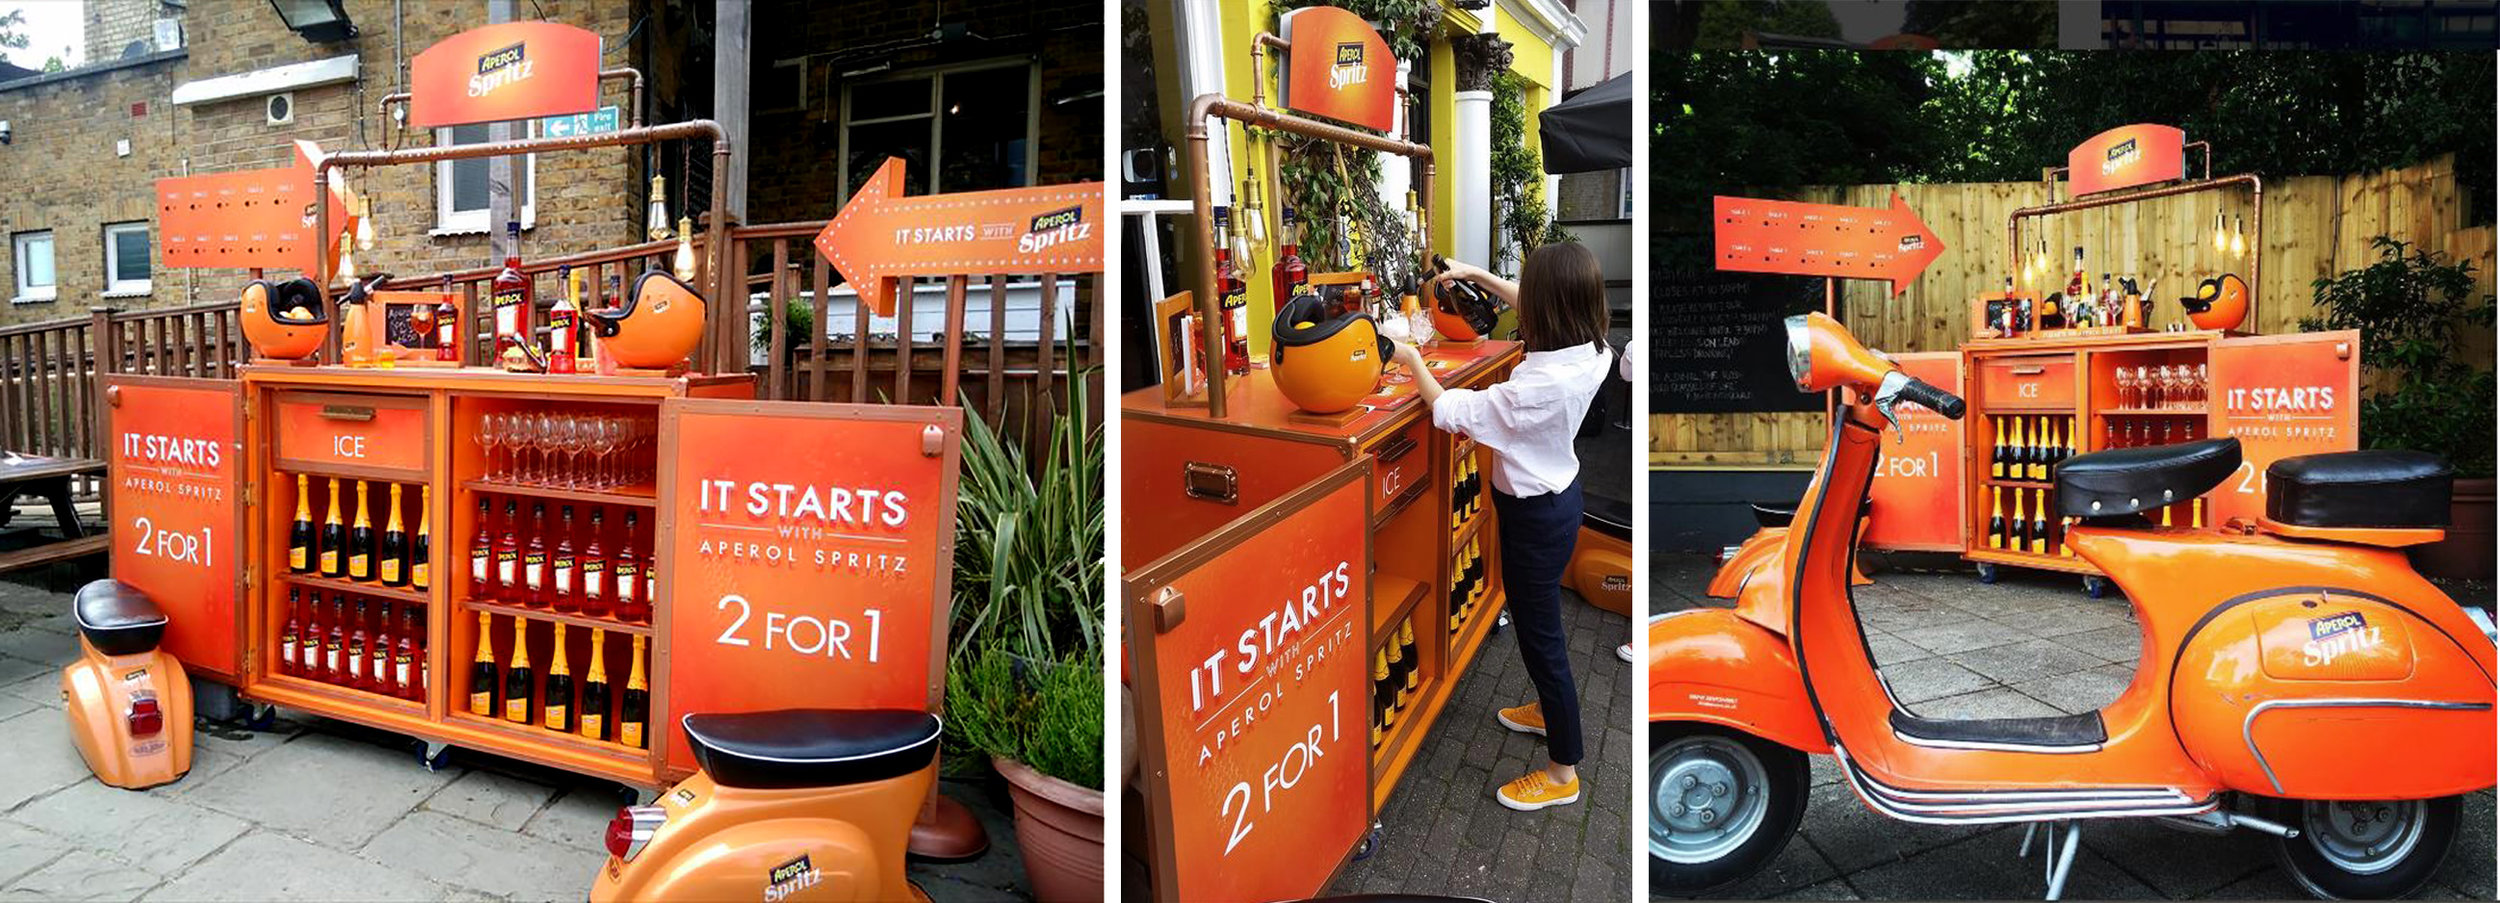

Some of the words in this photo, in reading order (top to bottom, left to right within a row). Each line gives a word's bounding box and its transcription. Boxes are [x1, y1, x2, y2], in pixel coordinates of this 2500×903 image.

[482, 50, 520, 71] APEROL
[1339, 46, 1361, 62] APEROL
[468, 60, 534, 97] Spritz
[1330, 62, 1367, 91] Spritz
[895, 228, 910, 245] IT
[913, 225, 975, 243] STARTS
[983, 225, 1013, 237] WITH
[1035, 211, 1077, 231] APEROL
[1018, 222, 1091, 253] Spritz
[2018, 383, 2040, 398] ICE
[2227, 388, 2247, 410] IT
[2250, 386, 2335, 410] STARTS
[333, 435, 365, 457] ICE
[2228, 426, 2278, 437] APEROL
[2286, 425, 2336, 438] SPRITZ
[124, 433, 141, 458] IT
[146, 434, 220, 467] STARTS
[1889, 456, 1927, 478] FOR
[1930, 451, 1939, 477] 1
[125, 477, 171, 493] APEROL
[178, 484, 221, 501] SPRITZ
[1382, 467, 1401, 500] ICE
[2237, 460, 2256, 493] 2
[701, 479, 735, 512] IT
[746, 482, 908, 526] STARTS
[135, 517, 152, 555] 2
[158, 530, 198, 564] FOR
[202, 528, 212, 567] 1
[778, 525, 823, 540] WITH
[700, 541, 797, 562] APEROL
[815, 550, 906, 572] SPRITZ
[1601, 582, 1631, 592] Spritz
[716, 595, 751, 646] 2
[765, 612, 852, 660] FOR
[863, 609, 881, 663] 1
[1191, 648, 1228, 712] IT
[1237, 561, 1350, 674] STARTS
[2316, 616, 2362, 637] APEROL
[1266, 642, 1301, 678] WITH
[2303, 624, 2381, 667] Spritz
[1199, 682, 1284, 766] APEROL
[1295, 621, 1352, 682] SPRITZ
[1221, 781, 1254, 858] 2
[1263, 724, 1325, 814] FOR
[1327, 689, 1340, 743] 1
[765, 868, 821, 902] Spritz
[775, 861, 808, 882] APEROL
